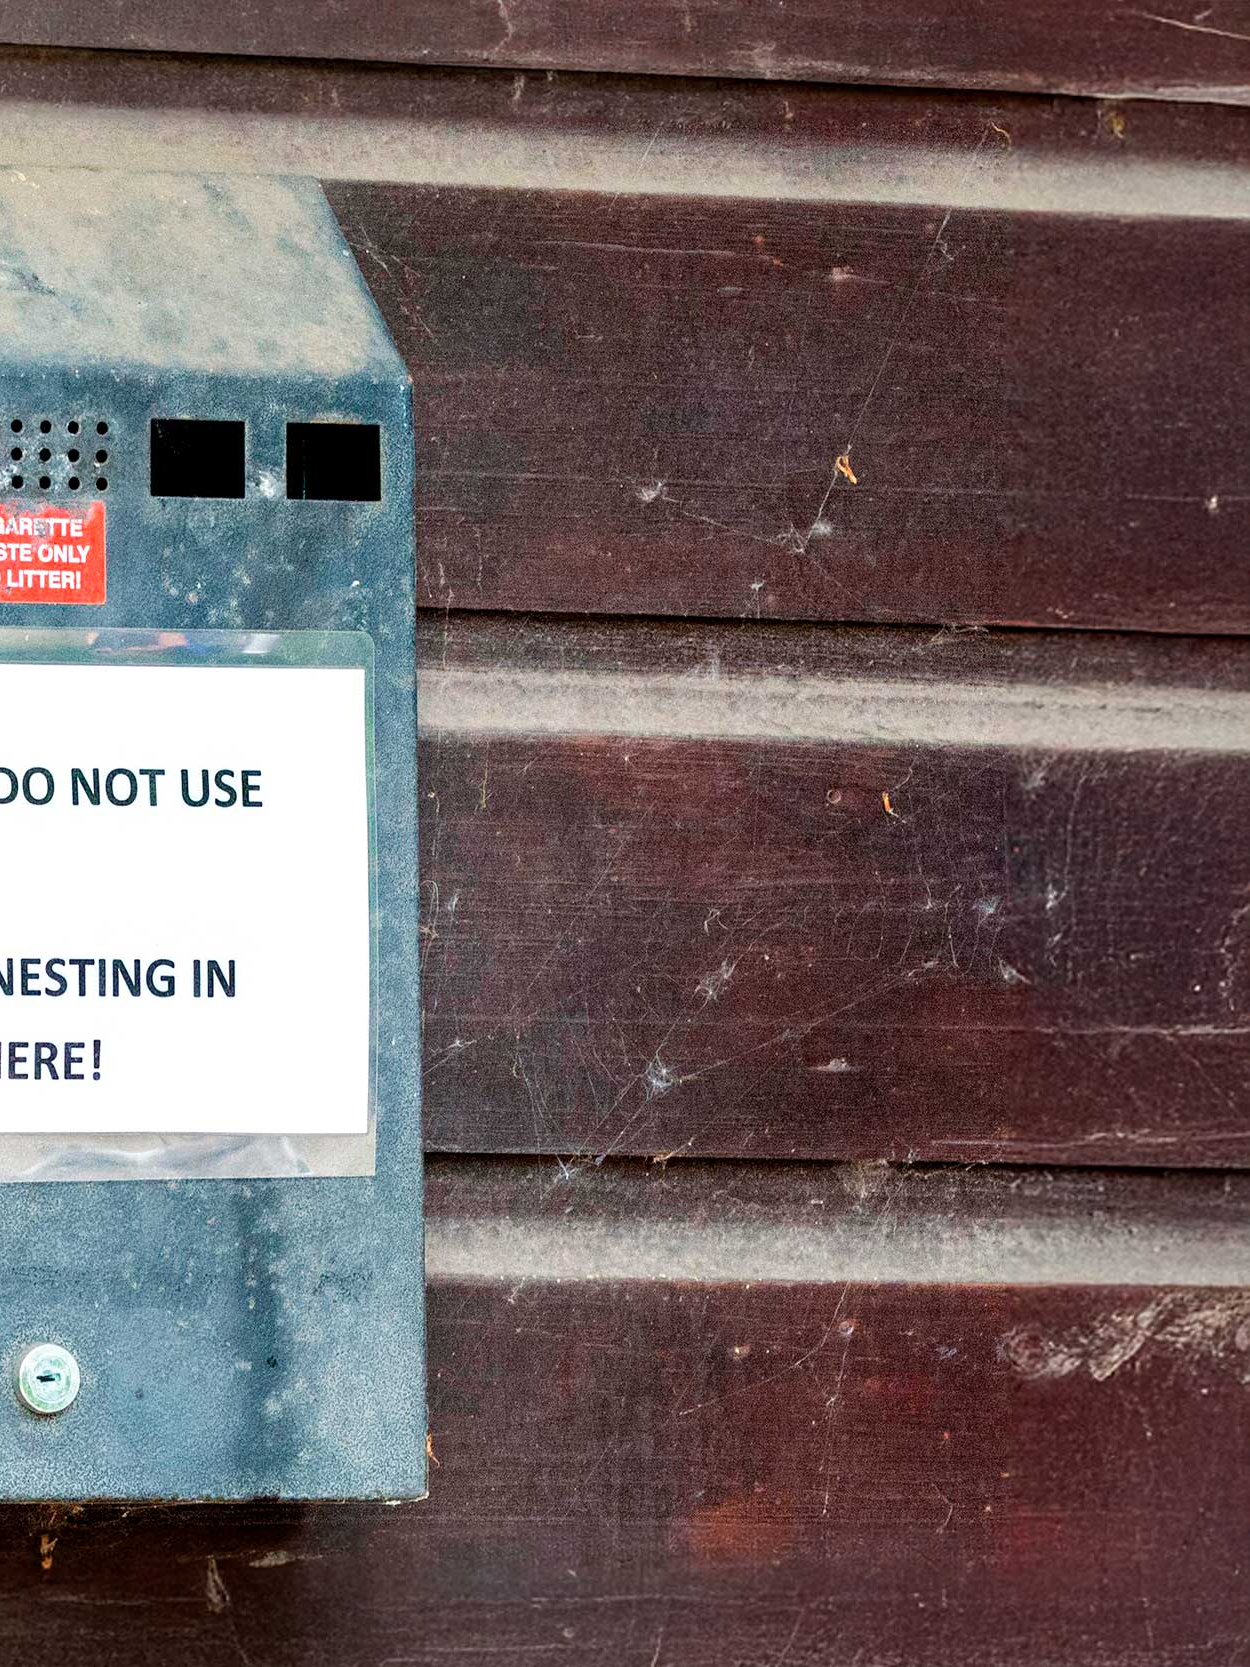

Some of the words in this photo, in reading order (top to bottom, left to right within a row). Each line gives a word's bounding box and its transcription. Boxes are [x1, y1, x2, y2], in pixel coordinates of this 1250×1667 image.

[37, 543, 90, 564] ONLY
[7, 570, 81, 590] LITTER!
[70, 767, 166, 807] NOT
[180, 768, 263, 808] USE
[193, 959, 236, 998] IN
